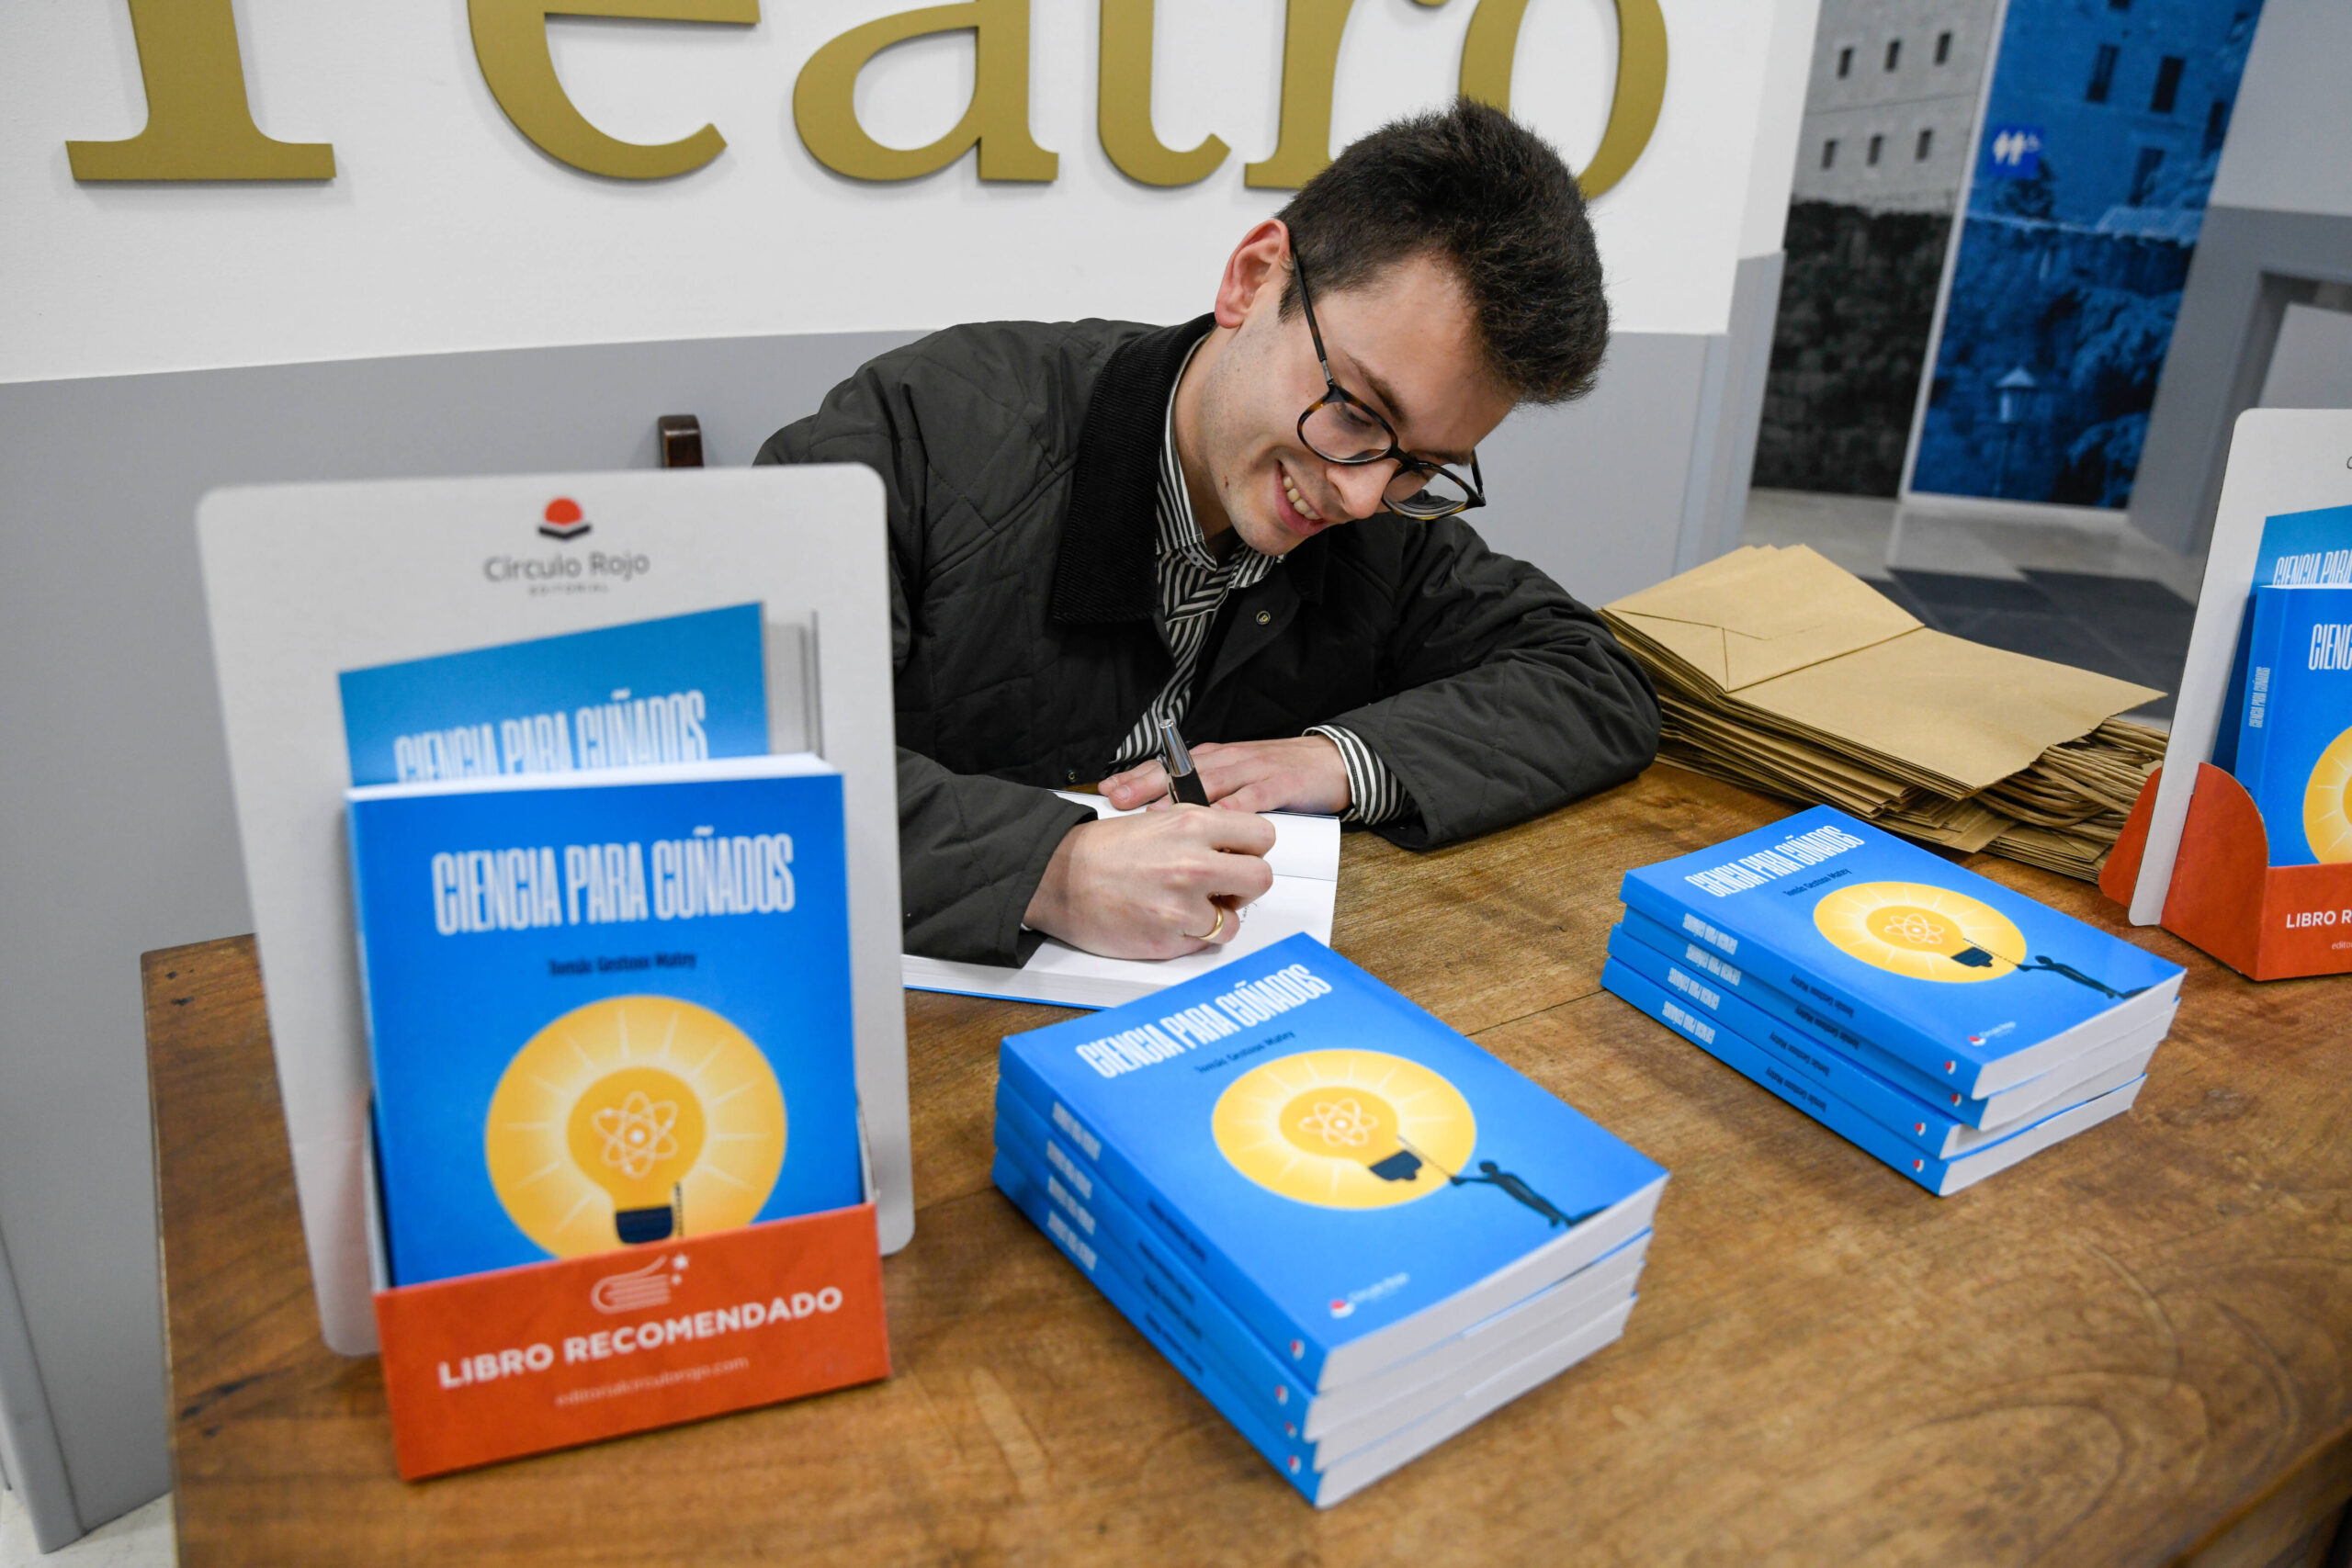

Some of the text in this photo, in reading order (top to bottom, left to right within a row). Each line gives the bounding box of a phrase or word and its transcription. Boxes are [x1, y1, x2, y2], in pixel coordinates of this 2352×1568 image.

[588, 550, 651, 581] Rojo
[393, 687, 709, 784] CIENCIA PARA CUÑADOS
[431, 825, 796, 936] CIENCIA PARA CUÑADOS
[1684, 825, 1865, 897] CIENCIA PARA CUÑADOS
[2286, 910, 2336, 929] LIBRO
[1075, 964, 1333, 1078] CIENCIA PARA CUÑADOS
[437, 1286, 843, 1390] LIBRO RECOMENDADO
